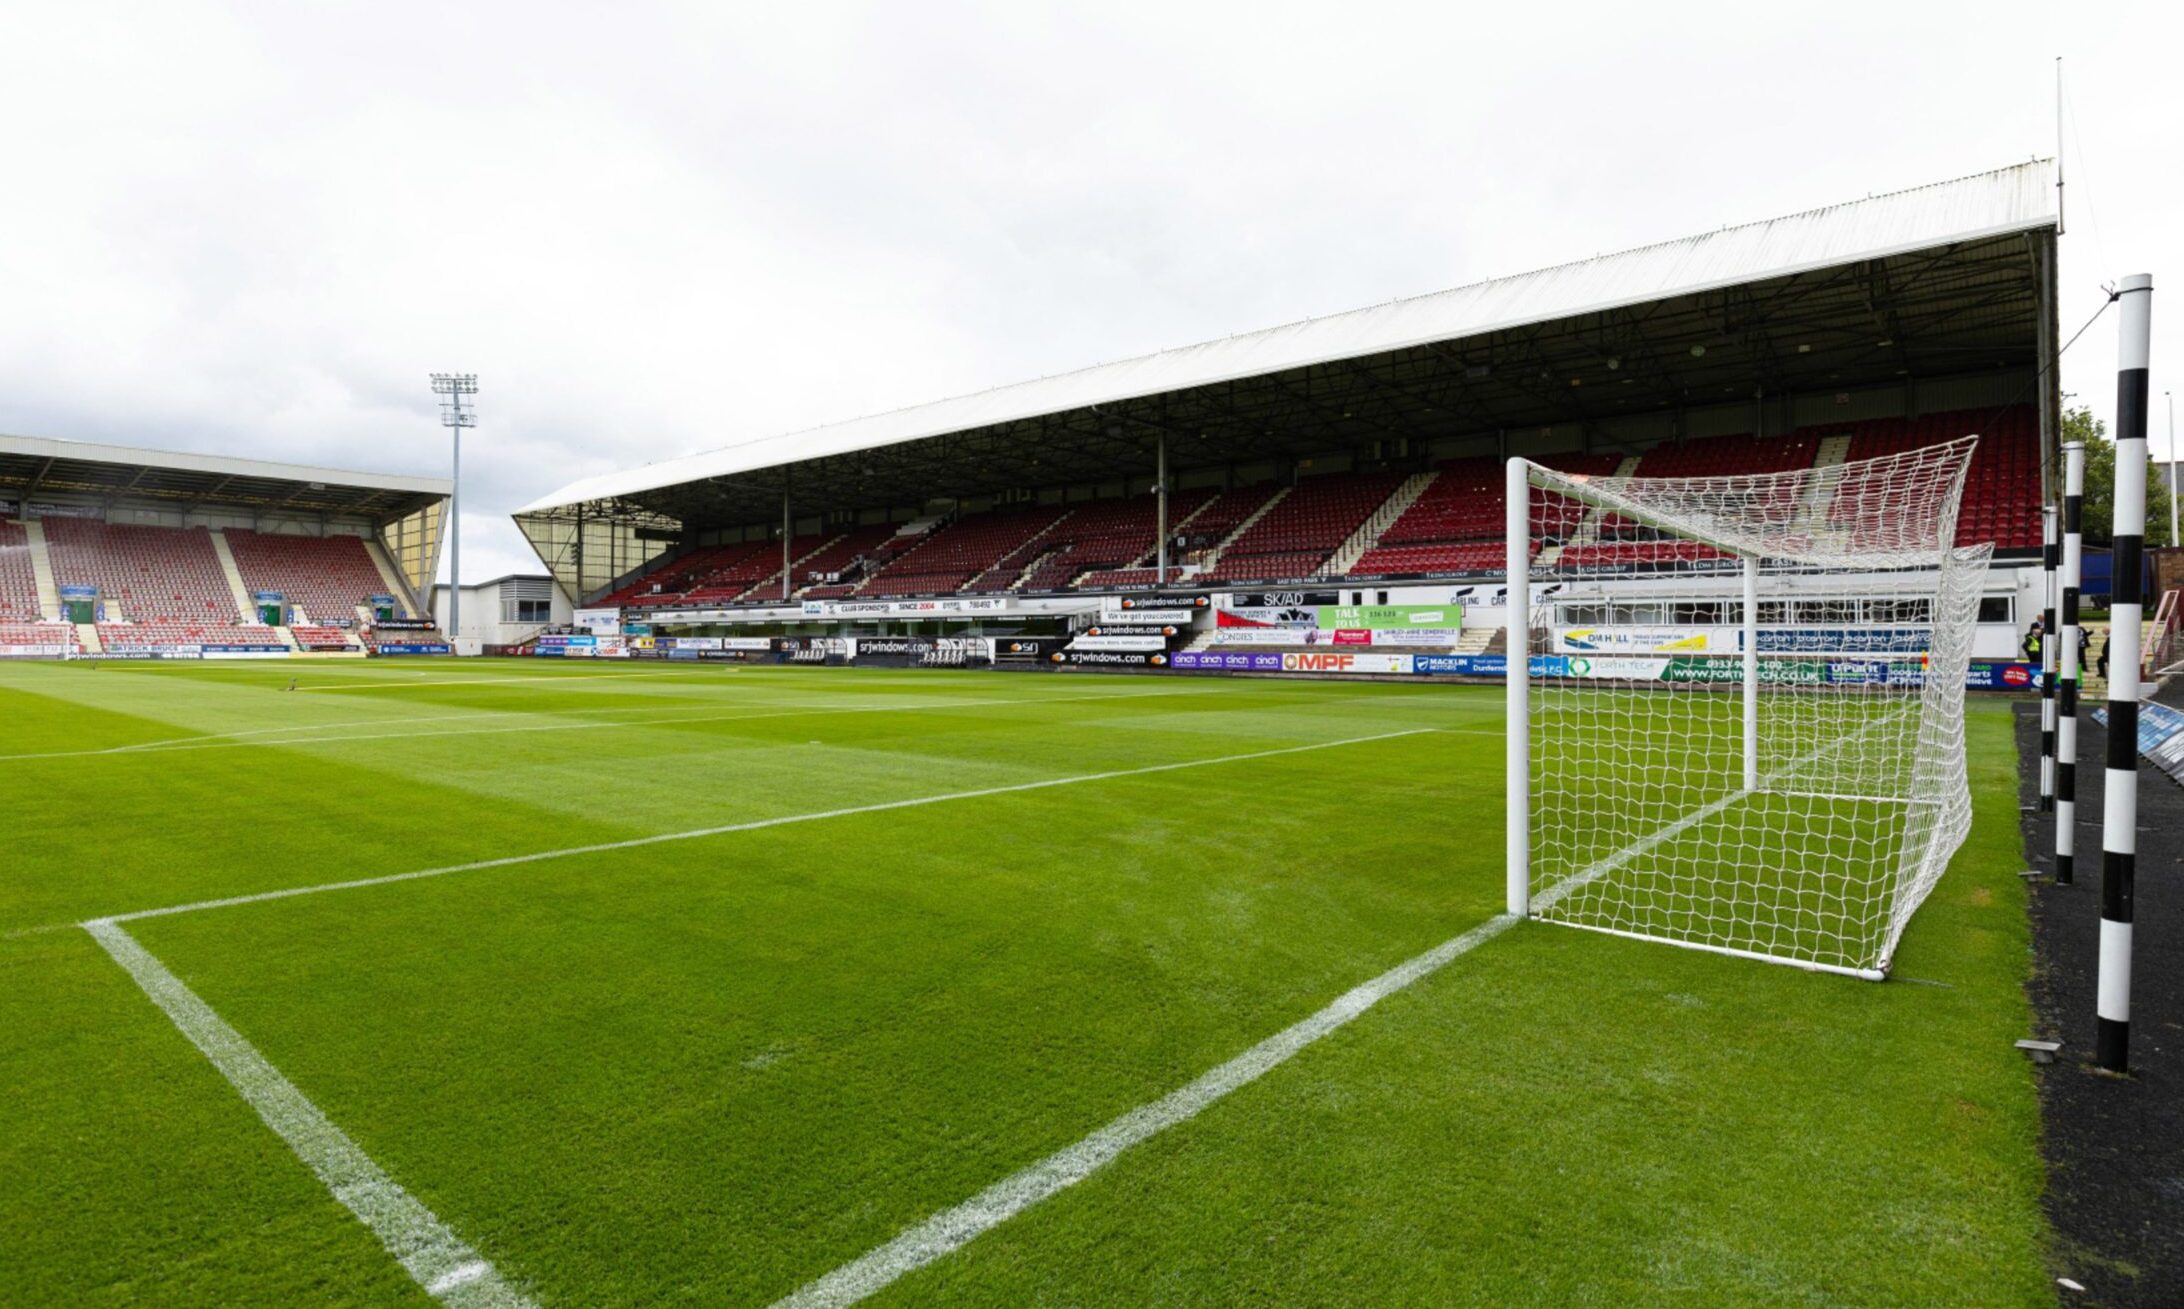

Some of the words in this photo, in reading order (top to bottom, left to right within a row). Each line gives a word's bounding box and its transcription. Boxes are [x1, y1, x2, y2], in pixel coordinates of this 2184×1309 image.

[1135, 597, 1195, 607] srjwindows.com
[1450, 596, 1480, 606] CARLING
[1335, 608, 1360, 619] TALK
[1349, 619, 1361, 628] US
[1102, 626, 1162, 635] srjwindows.com
[1070, 652, 1146, 664] srjwindows.com
[1174, 654, 1196, 664] cinch
[1200, 654, 1222, 665] cinch
[1225, 655, 1249, 665] cinch
[1255, 655, 1278, 666] cinch
[1429, 658, 1468, 667] MACKLIN
[1298, 655, 1356, 672] MPF
[1473, 664, 1507, 672] Dunferml
